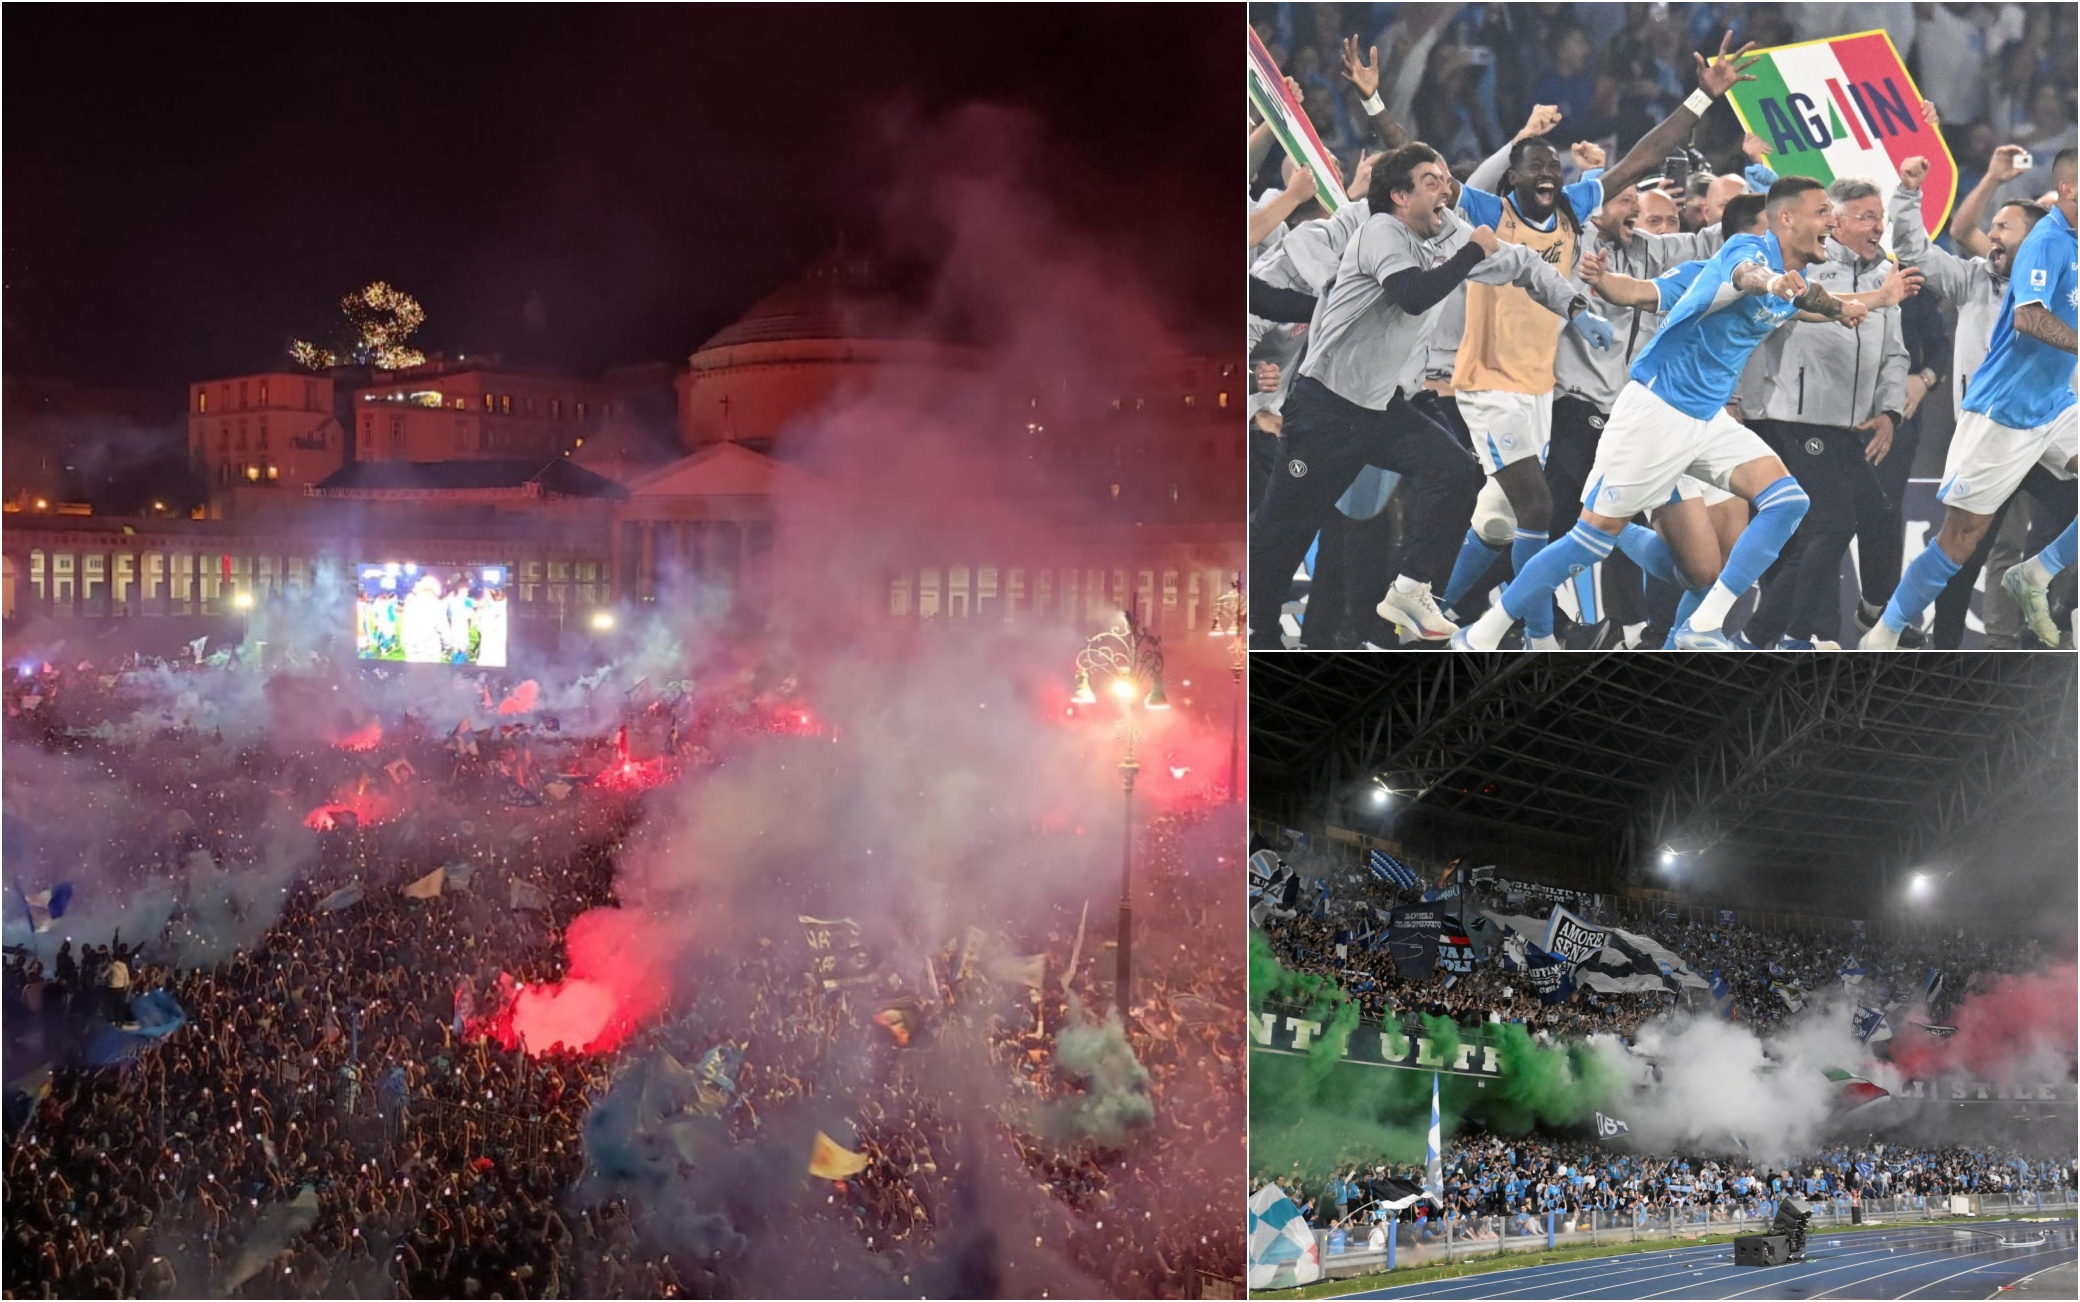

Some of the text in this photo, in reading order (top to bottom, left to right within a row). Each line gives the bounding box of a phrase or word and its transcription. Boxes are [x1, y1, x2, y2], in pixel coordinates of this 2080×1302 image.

[1758, 77, 1919, 156] AGAIN
[1820, 272, 1837, 280] EA7
[1559, 921, 1604, 947] AMORE
[1554, 937, 1588, 964] SENZ
